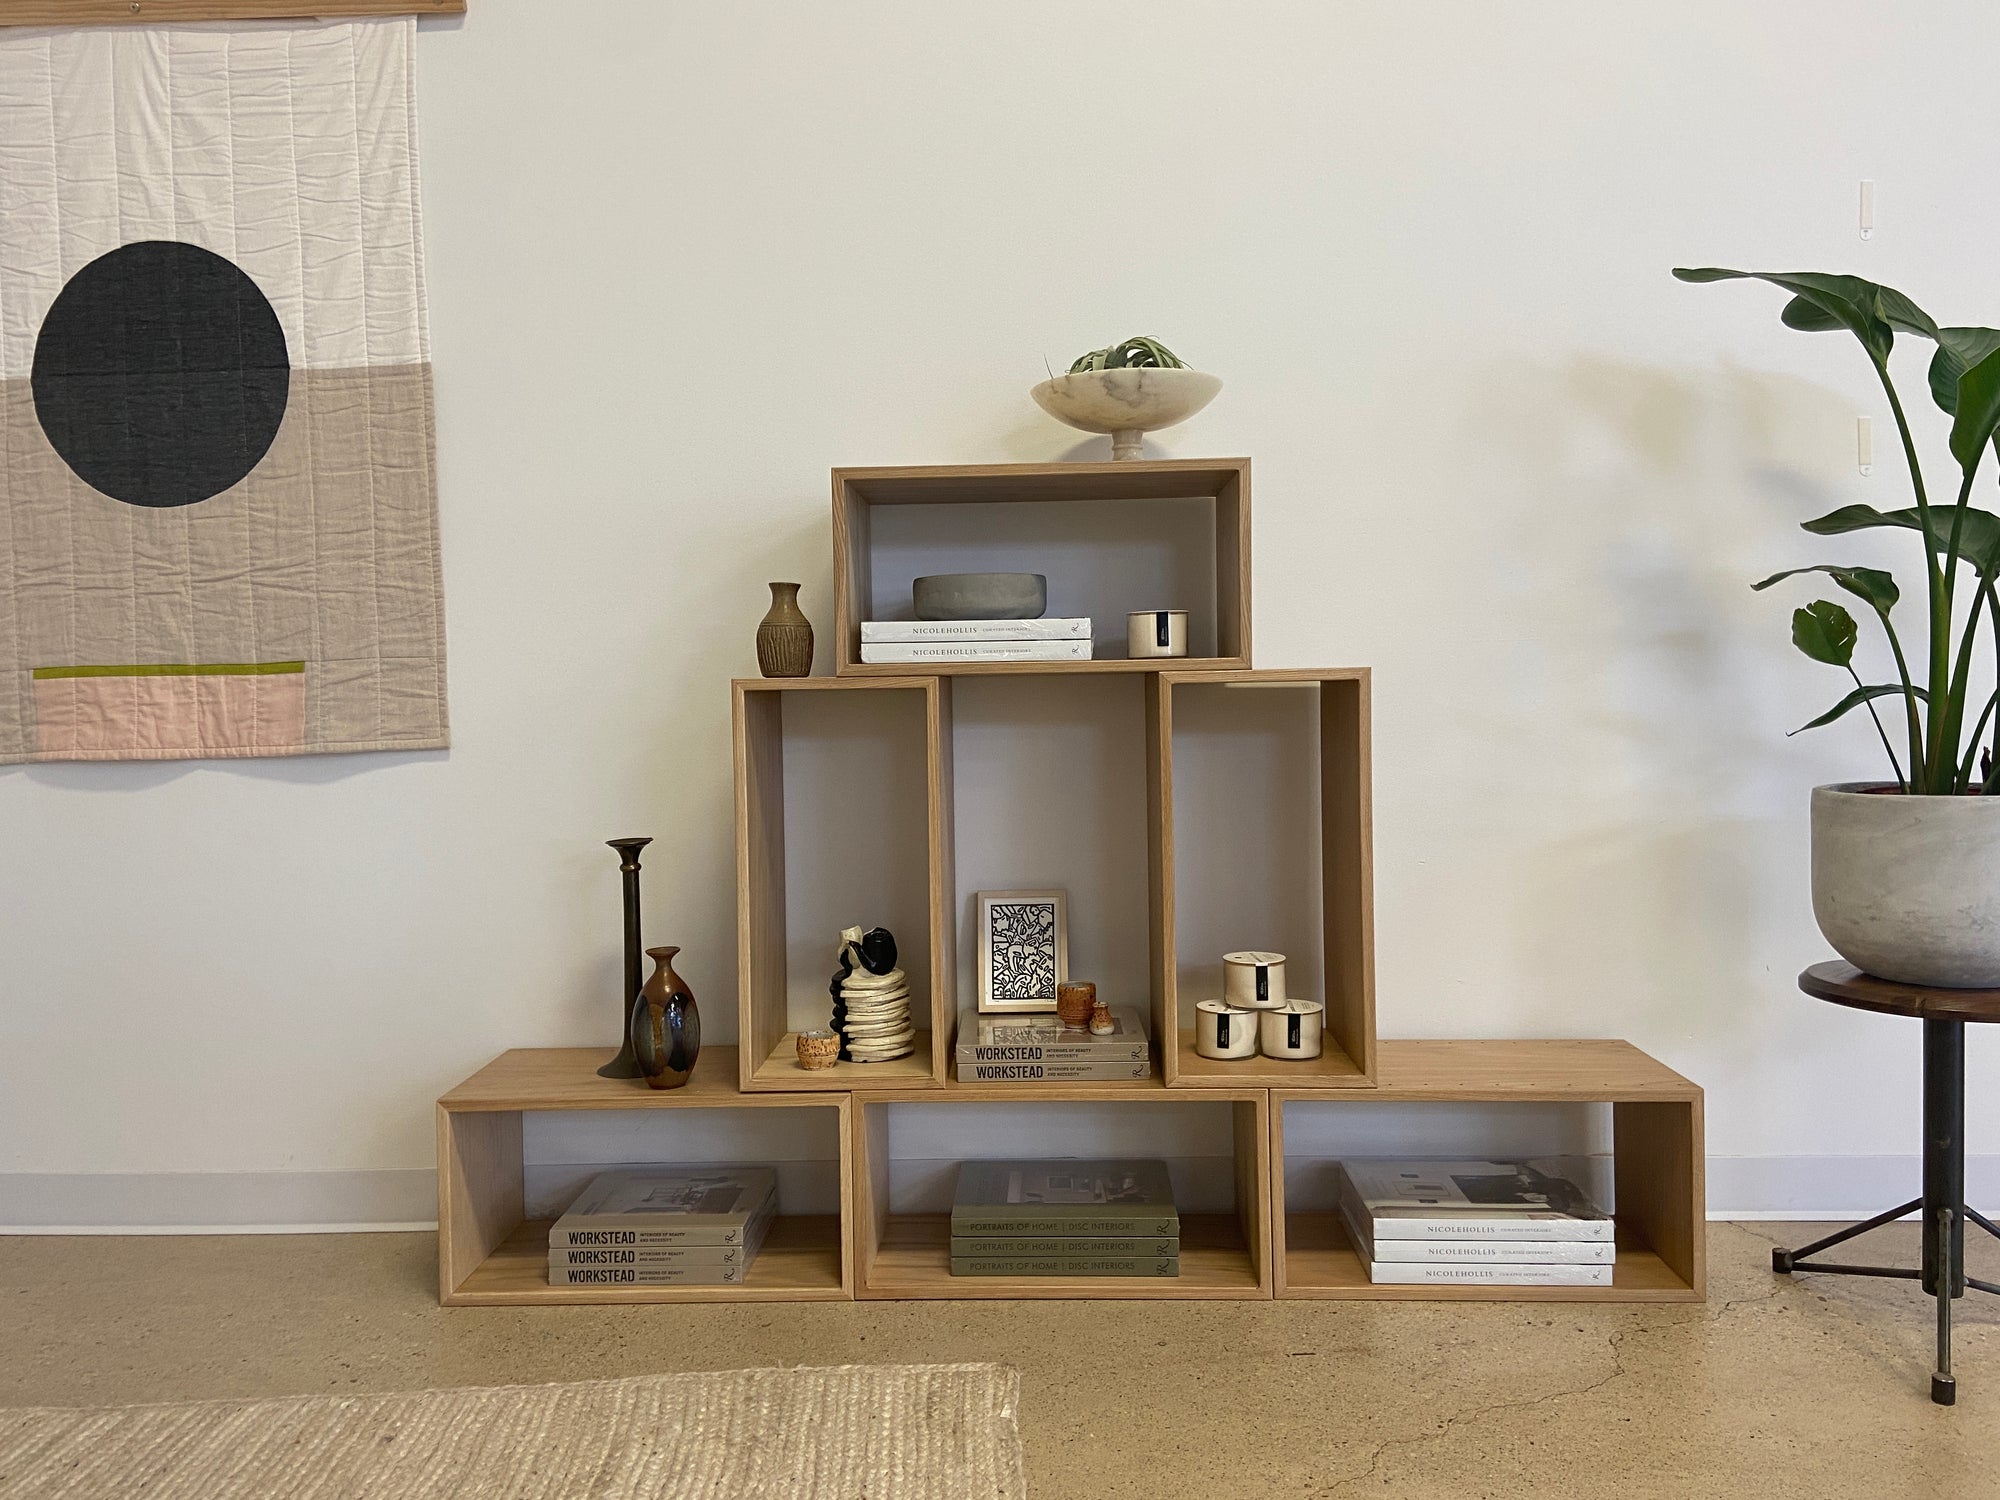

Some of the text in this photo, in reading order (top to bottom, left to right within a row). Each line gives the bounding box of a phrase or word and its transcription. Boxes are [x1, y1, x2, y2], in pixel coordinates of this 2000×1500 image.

[975, 1047, 1042, 1060] WORKSTEAD
[976, 1065, 1043, 1079] WORKSTEAD
[970, 1223, 1135, 1231] PORTRAITS OF HOME DISC INTERIORS
[568, 1231, 636, 1245] WORKSTEAD
[970, 1243, 1135, 1251] PORTRAITS OF HOME DISC INTERIORS
[568, 1250, 635, 1264] WORKSTEAD
[970, 1262, 1135, 1270] PORTRAITS OF HOME DISC INTERIORS
[568, 1269, 635, 1283] WORKSTEAD
